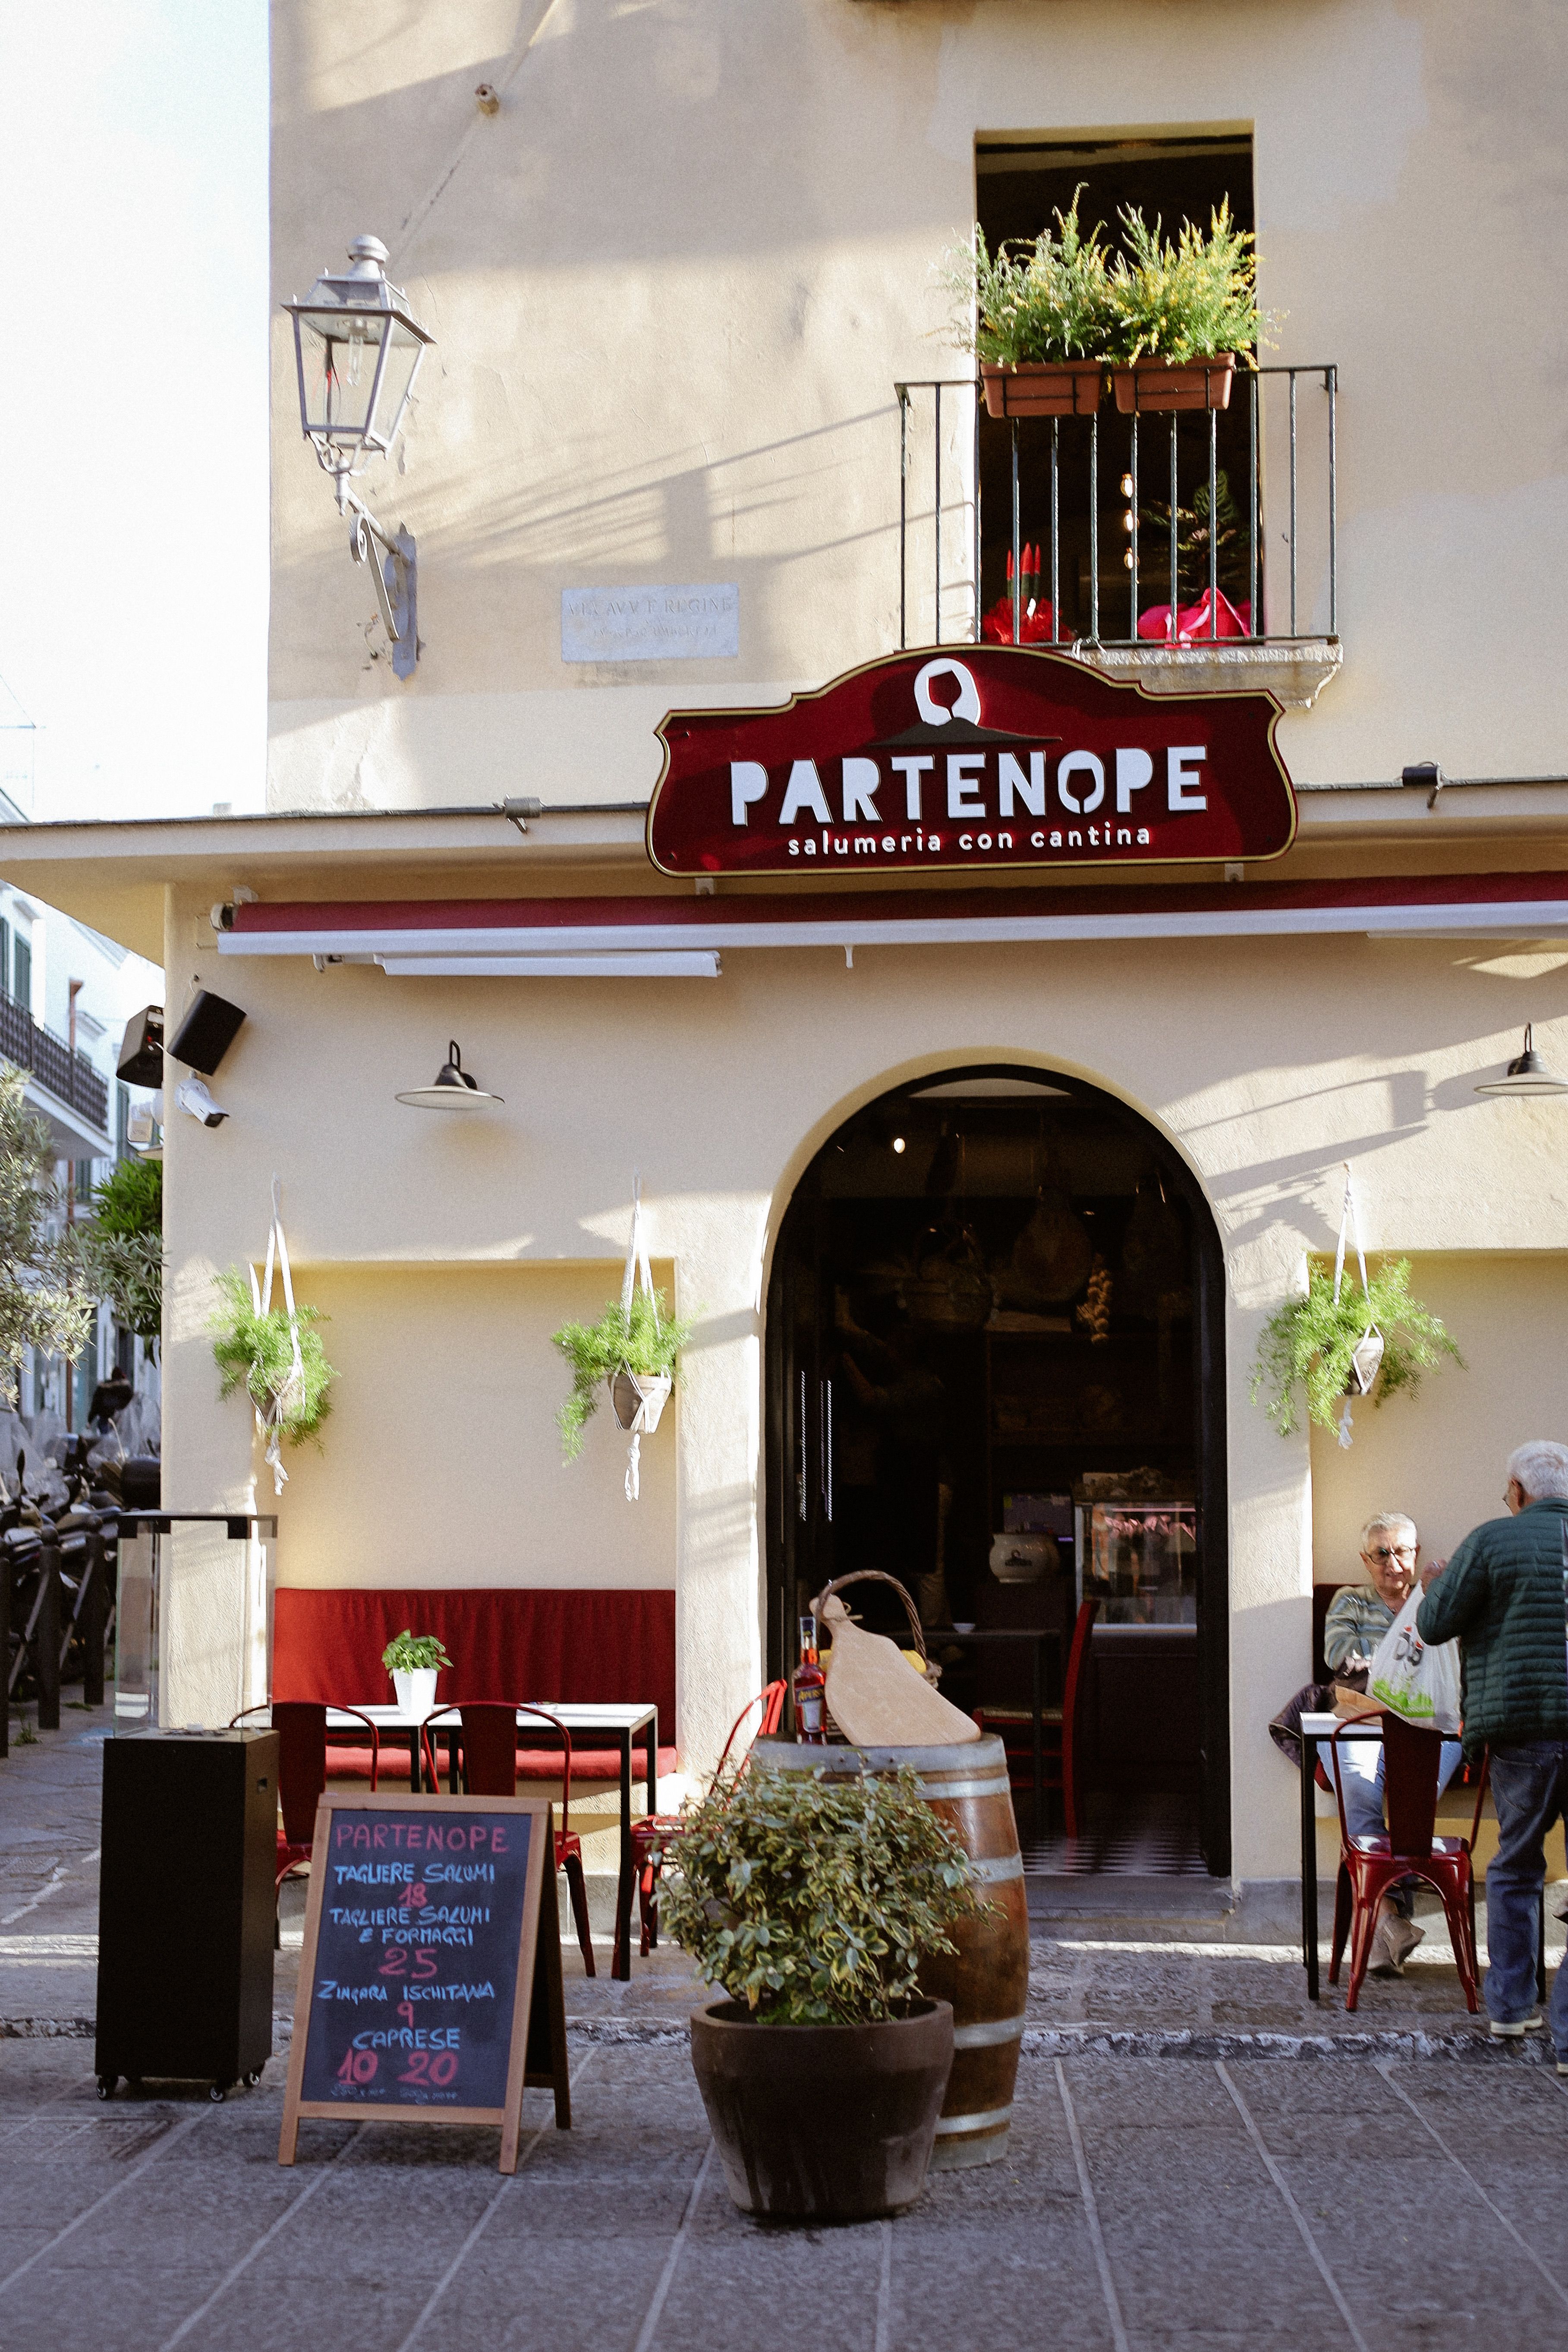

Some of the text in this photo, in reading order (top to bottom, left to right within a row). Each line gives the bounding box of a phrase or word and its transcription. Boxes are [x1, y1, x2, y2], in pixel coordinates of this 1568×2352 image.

[730, 746, 1207, 825] PARTENOPE
[789, 822, 1149, 855] salumeria con cantina
[337, 1824, 507, 1852] PARTENOPE
[334, 1861, 495, 1885] TAGLIERE SALUMI
[399, 1883, 427, 1907] 18
[330, 1906, 490, 1926] TAGLIERE SALUMI
[359, 1926, 473, 1946] E FORMAGGI
[379, 1947, 438, 1978] 25
[403, 1981, 495, 2003] ISCHITANA
[397, 2002, 414, 2028] 9
[353, 2027, 460, 2050] CAPRESE
[337, 2049, 458, 2085] 10 20
